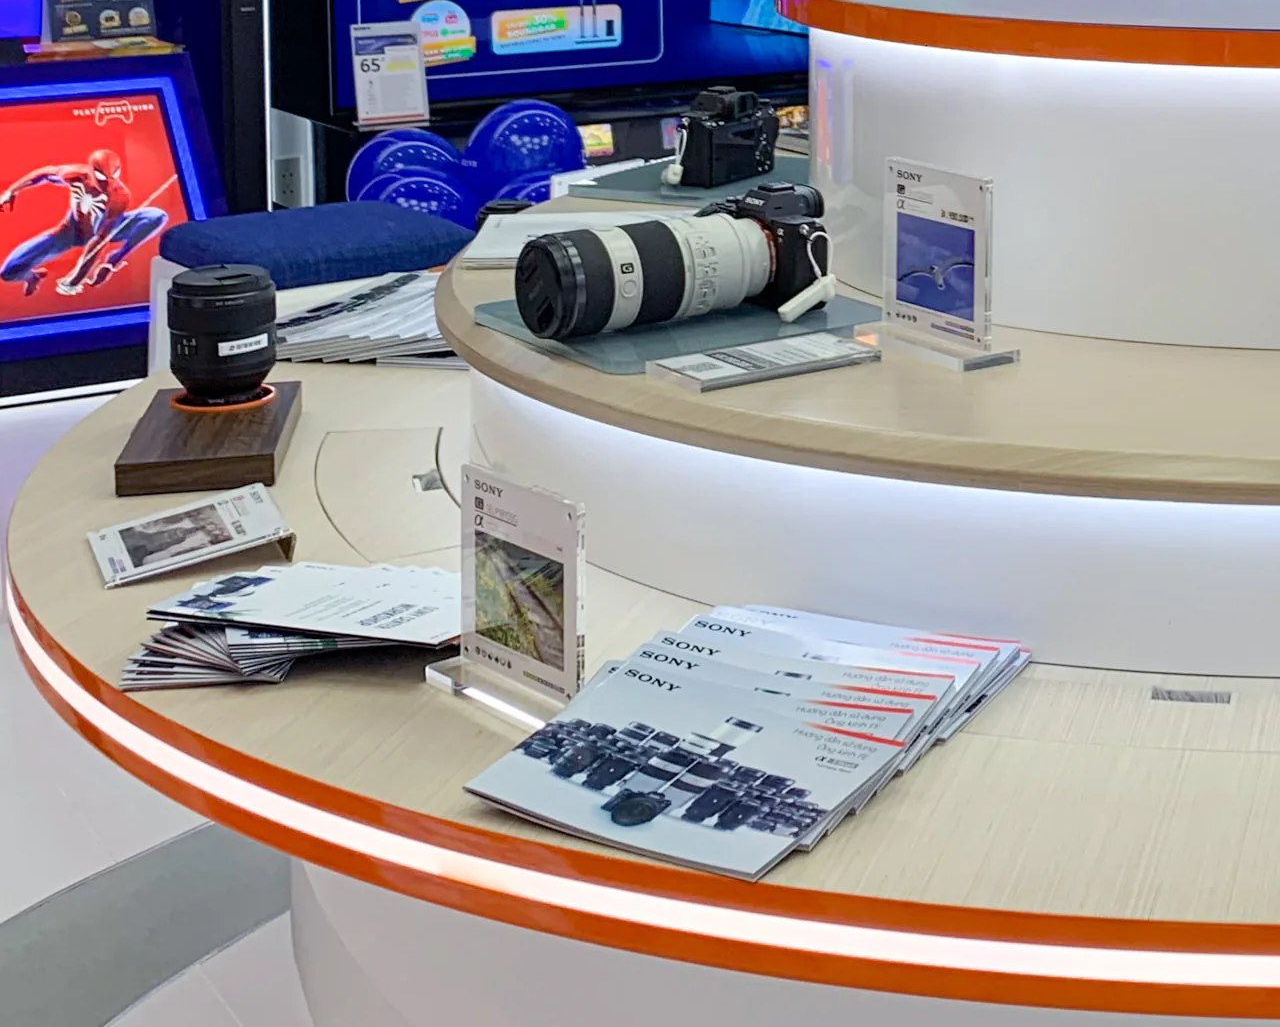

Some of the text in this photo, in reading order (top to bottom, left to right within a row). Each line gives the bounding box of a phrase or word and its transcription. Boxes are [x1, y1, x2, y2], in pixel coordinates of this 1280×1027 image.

[897, 170, 922, 183] SONY
[474, 479, 504, 498] SONY
[694, 620, 752, 637] SONY
[661, 636, 720, 656] SONY
[639, 650, 699, 670] SONY
[624, 668, 682, 692] SONY
